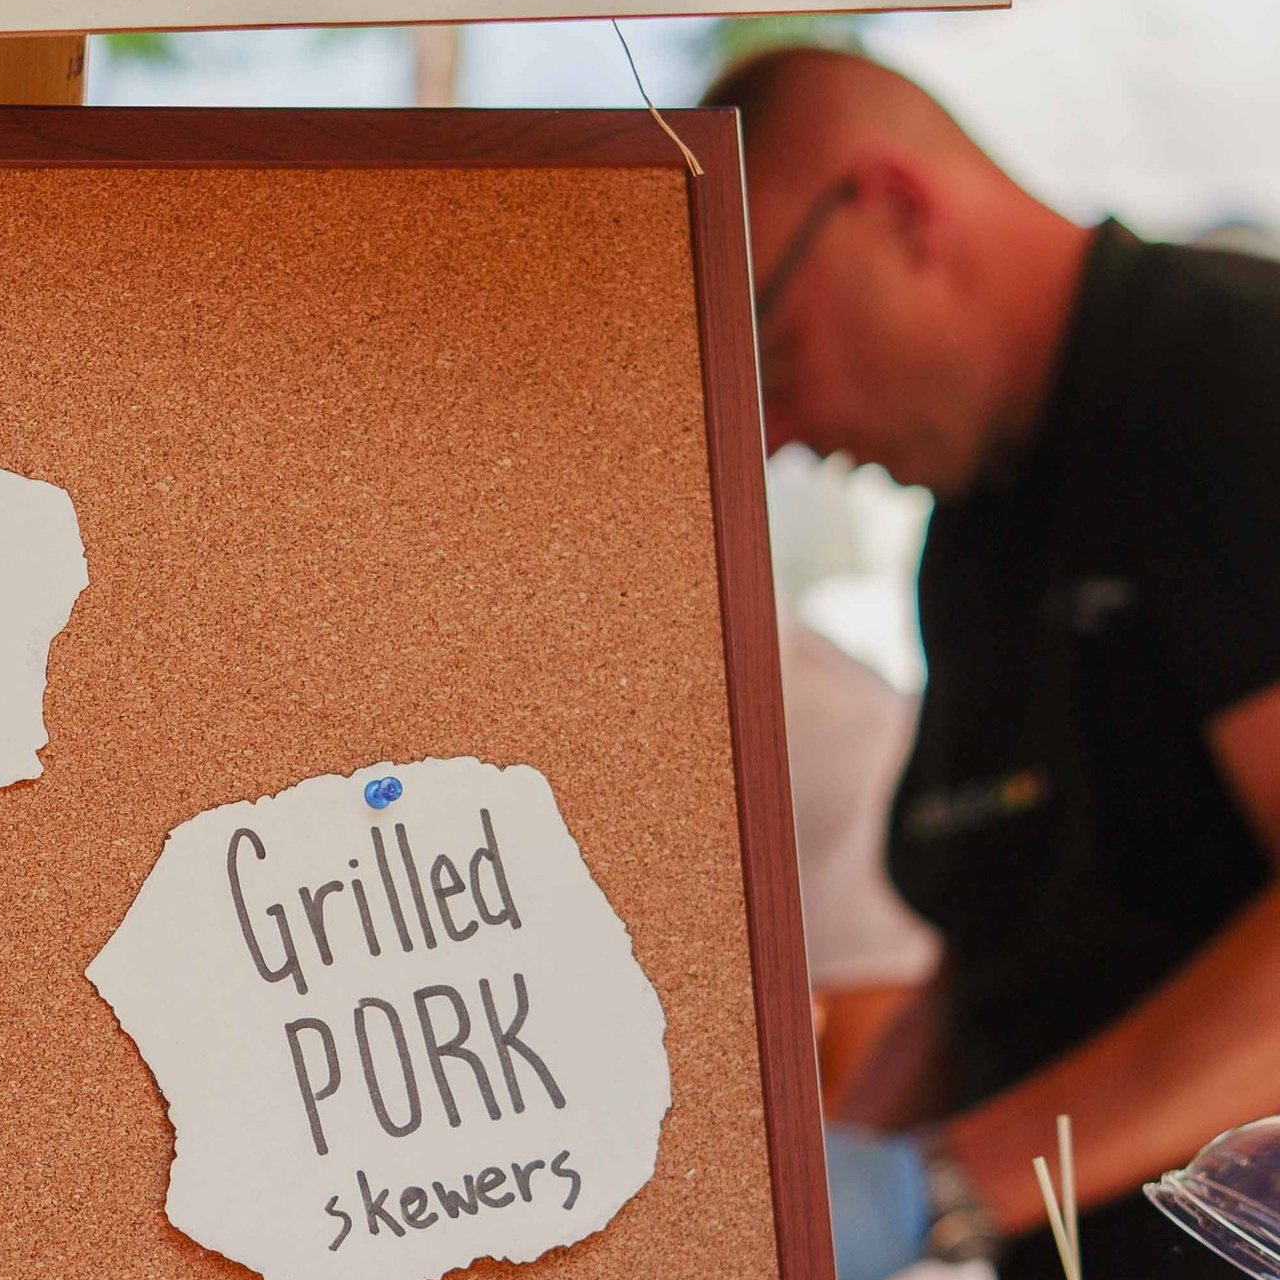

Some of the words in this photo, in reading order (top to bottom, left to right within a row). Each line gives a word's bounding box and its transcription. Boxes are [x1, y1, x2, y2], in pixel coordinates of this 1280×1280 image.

[227, 809, 522, 995] Grilled
[285, 973, 566, 1156] PORK
[324, 1150, 583, 1251] skewers
